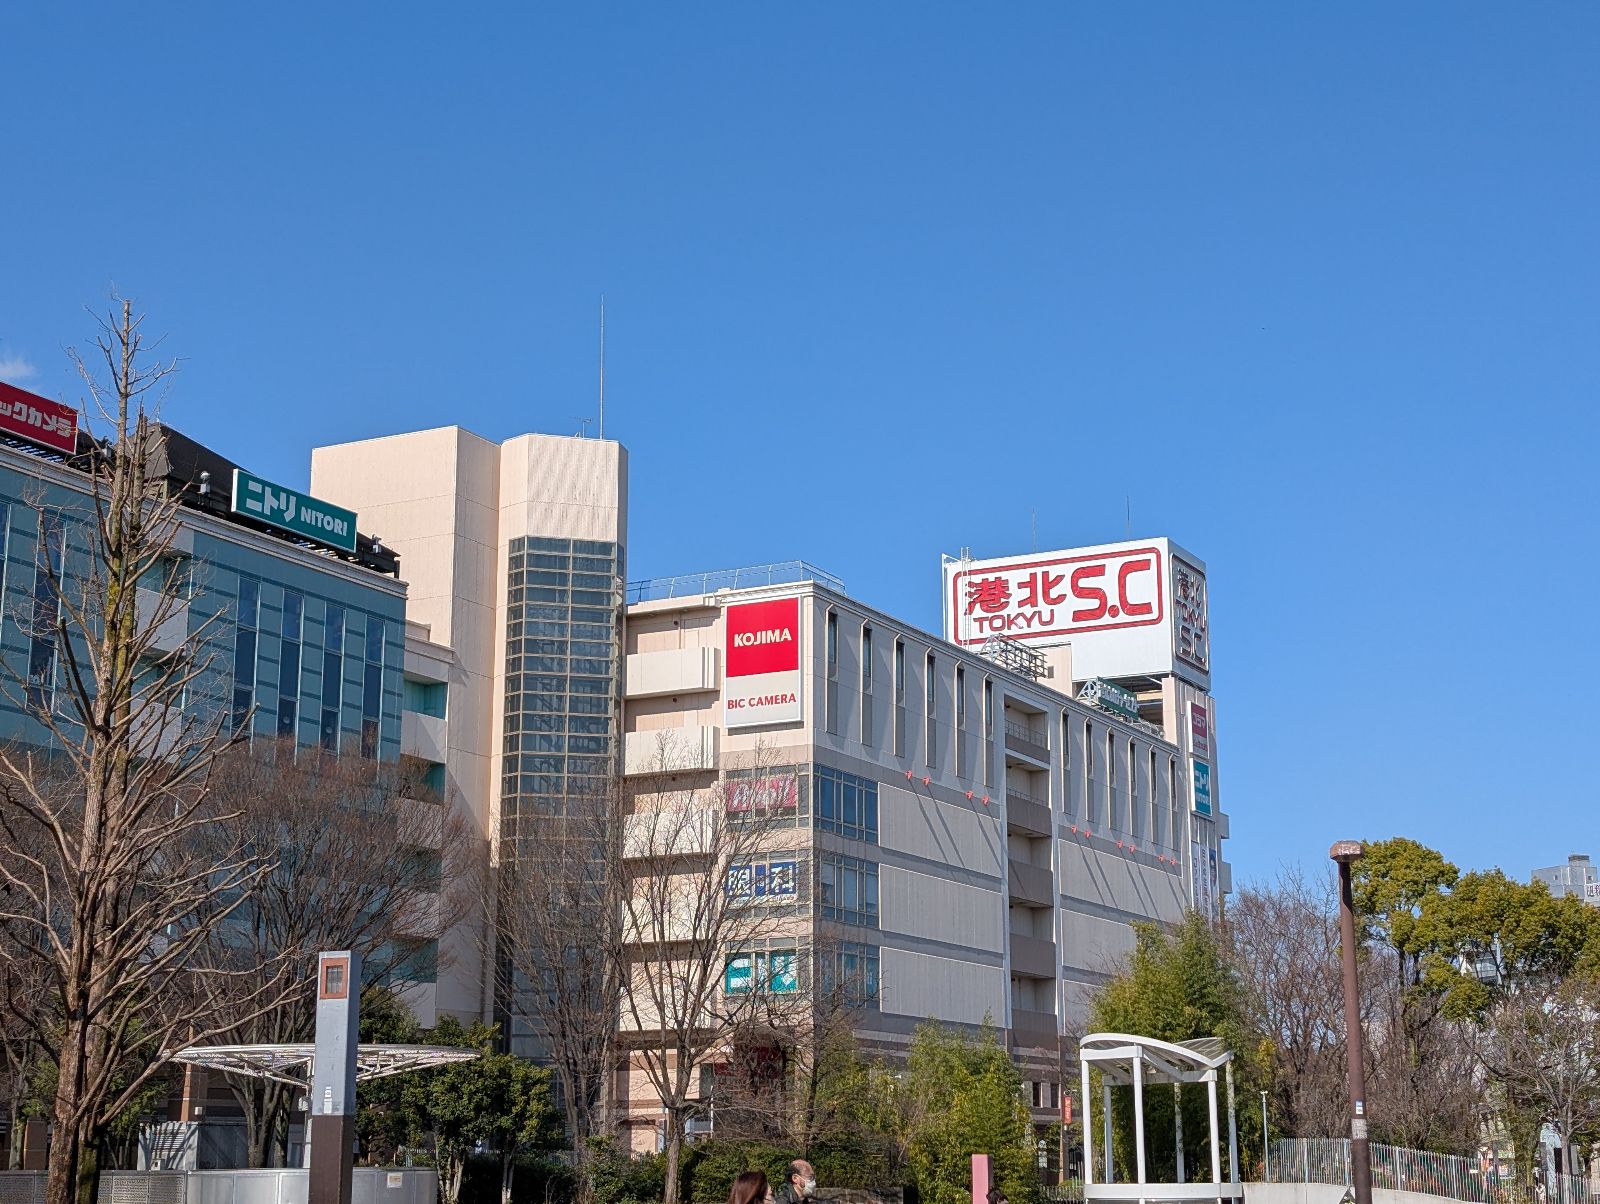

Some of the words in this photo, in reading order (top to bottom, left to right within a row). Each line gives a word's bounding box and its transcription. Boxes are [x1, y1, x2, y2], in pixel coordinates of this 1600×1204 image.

[246, 480, 297, 522] ニトリ
[301, 506, 347, 537] NITORI
[965, 570, 1067, 615] 港北
[973, 609, 1055, 633] TOKYU
[733, 627, 792, 648] KOJIMA
[727, 698, 746, 710] BIC
[748, 692, 797, 708] CAMERA
